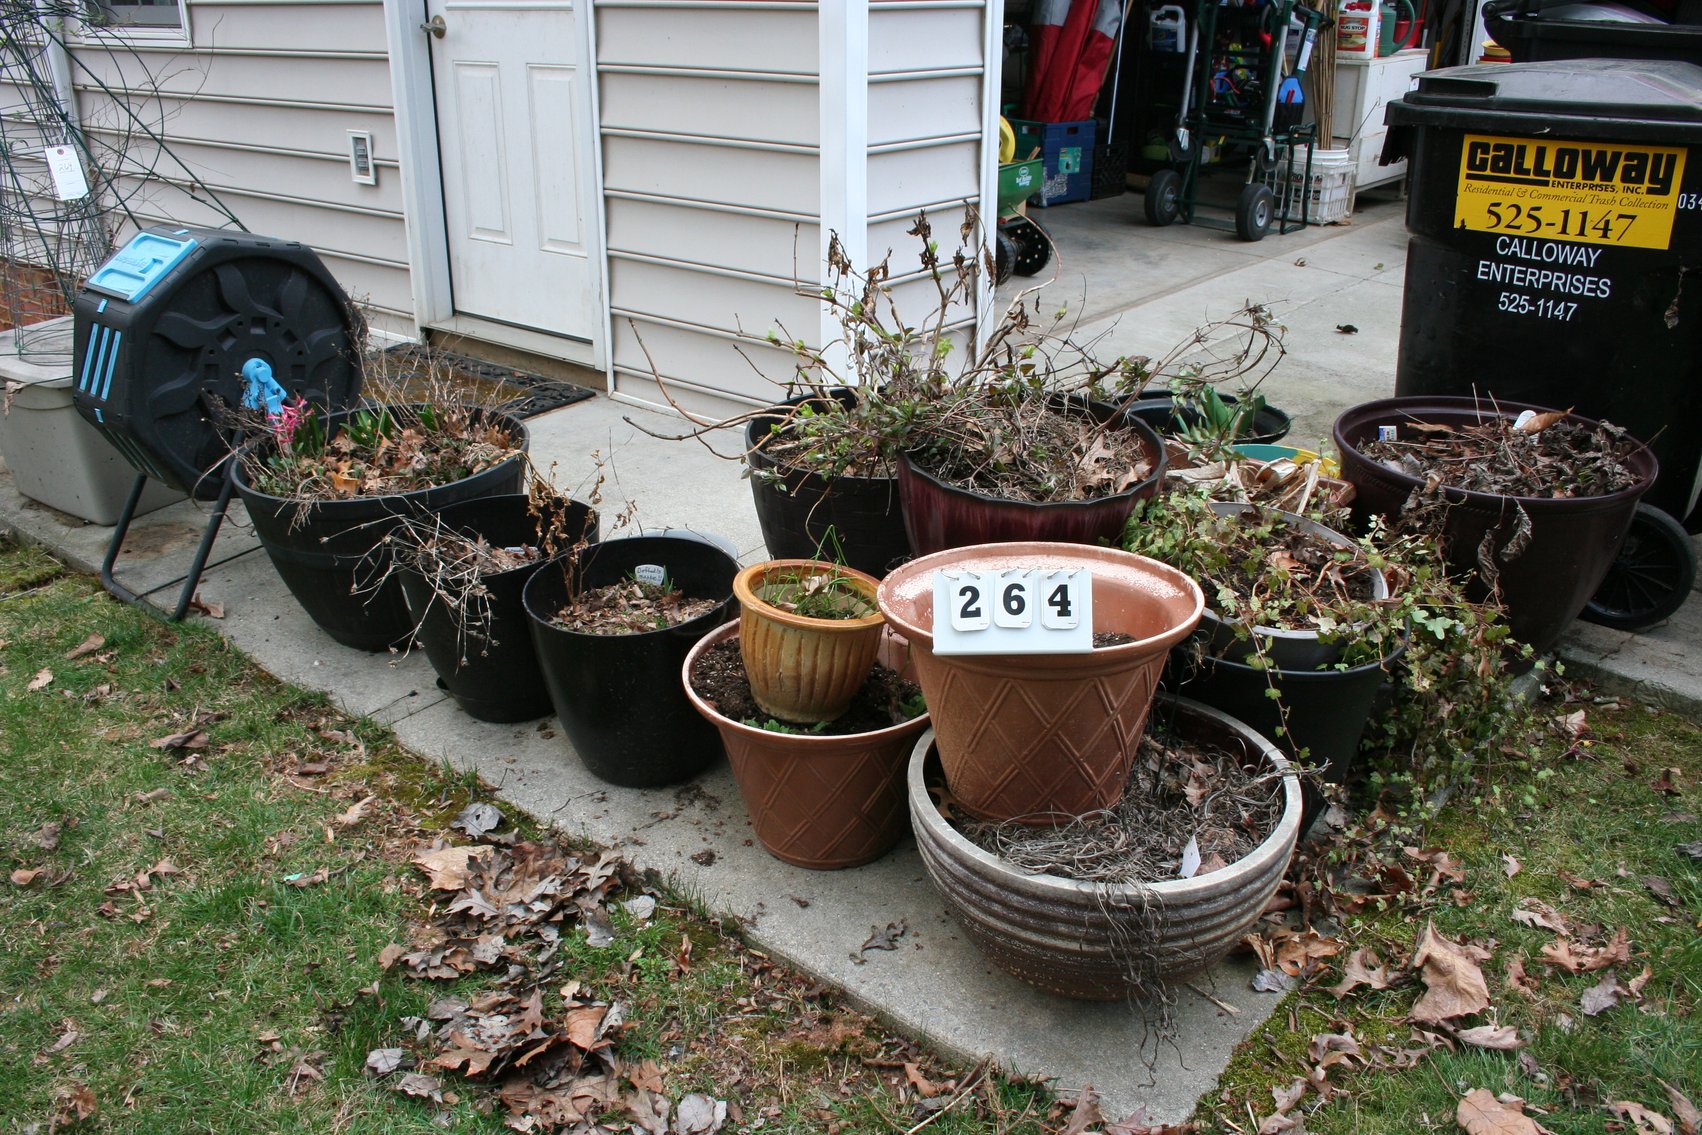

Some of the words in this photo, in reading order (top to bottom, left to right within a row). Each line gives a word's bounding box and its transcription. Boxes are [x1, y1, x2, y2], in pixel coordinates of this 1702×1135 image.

[1464, 183, 1514, 197] Residential
[1516, 188, 1528, 198] &
[1529, 189, 1587, 204] Commercial
[1589, 194, 1617, 206] Trash
[1619, 197, 1670, 210] Collection
[1551, 180, 1619, 193] ENTERPRISES,
[1622, 185, 1645, 195] INC.
[1486, 202, 1638, 242] 525-1147
[1496, 236, 1602, 268] CALLOWAY
[1477, 260, 1612, 298] ENTERPRISES
[1498, 292, 1578, 322] 525-1147
